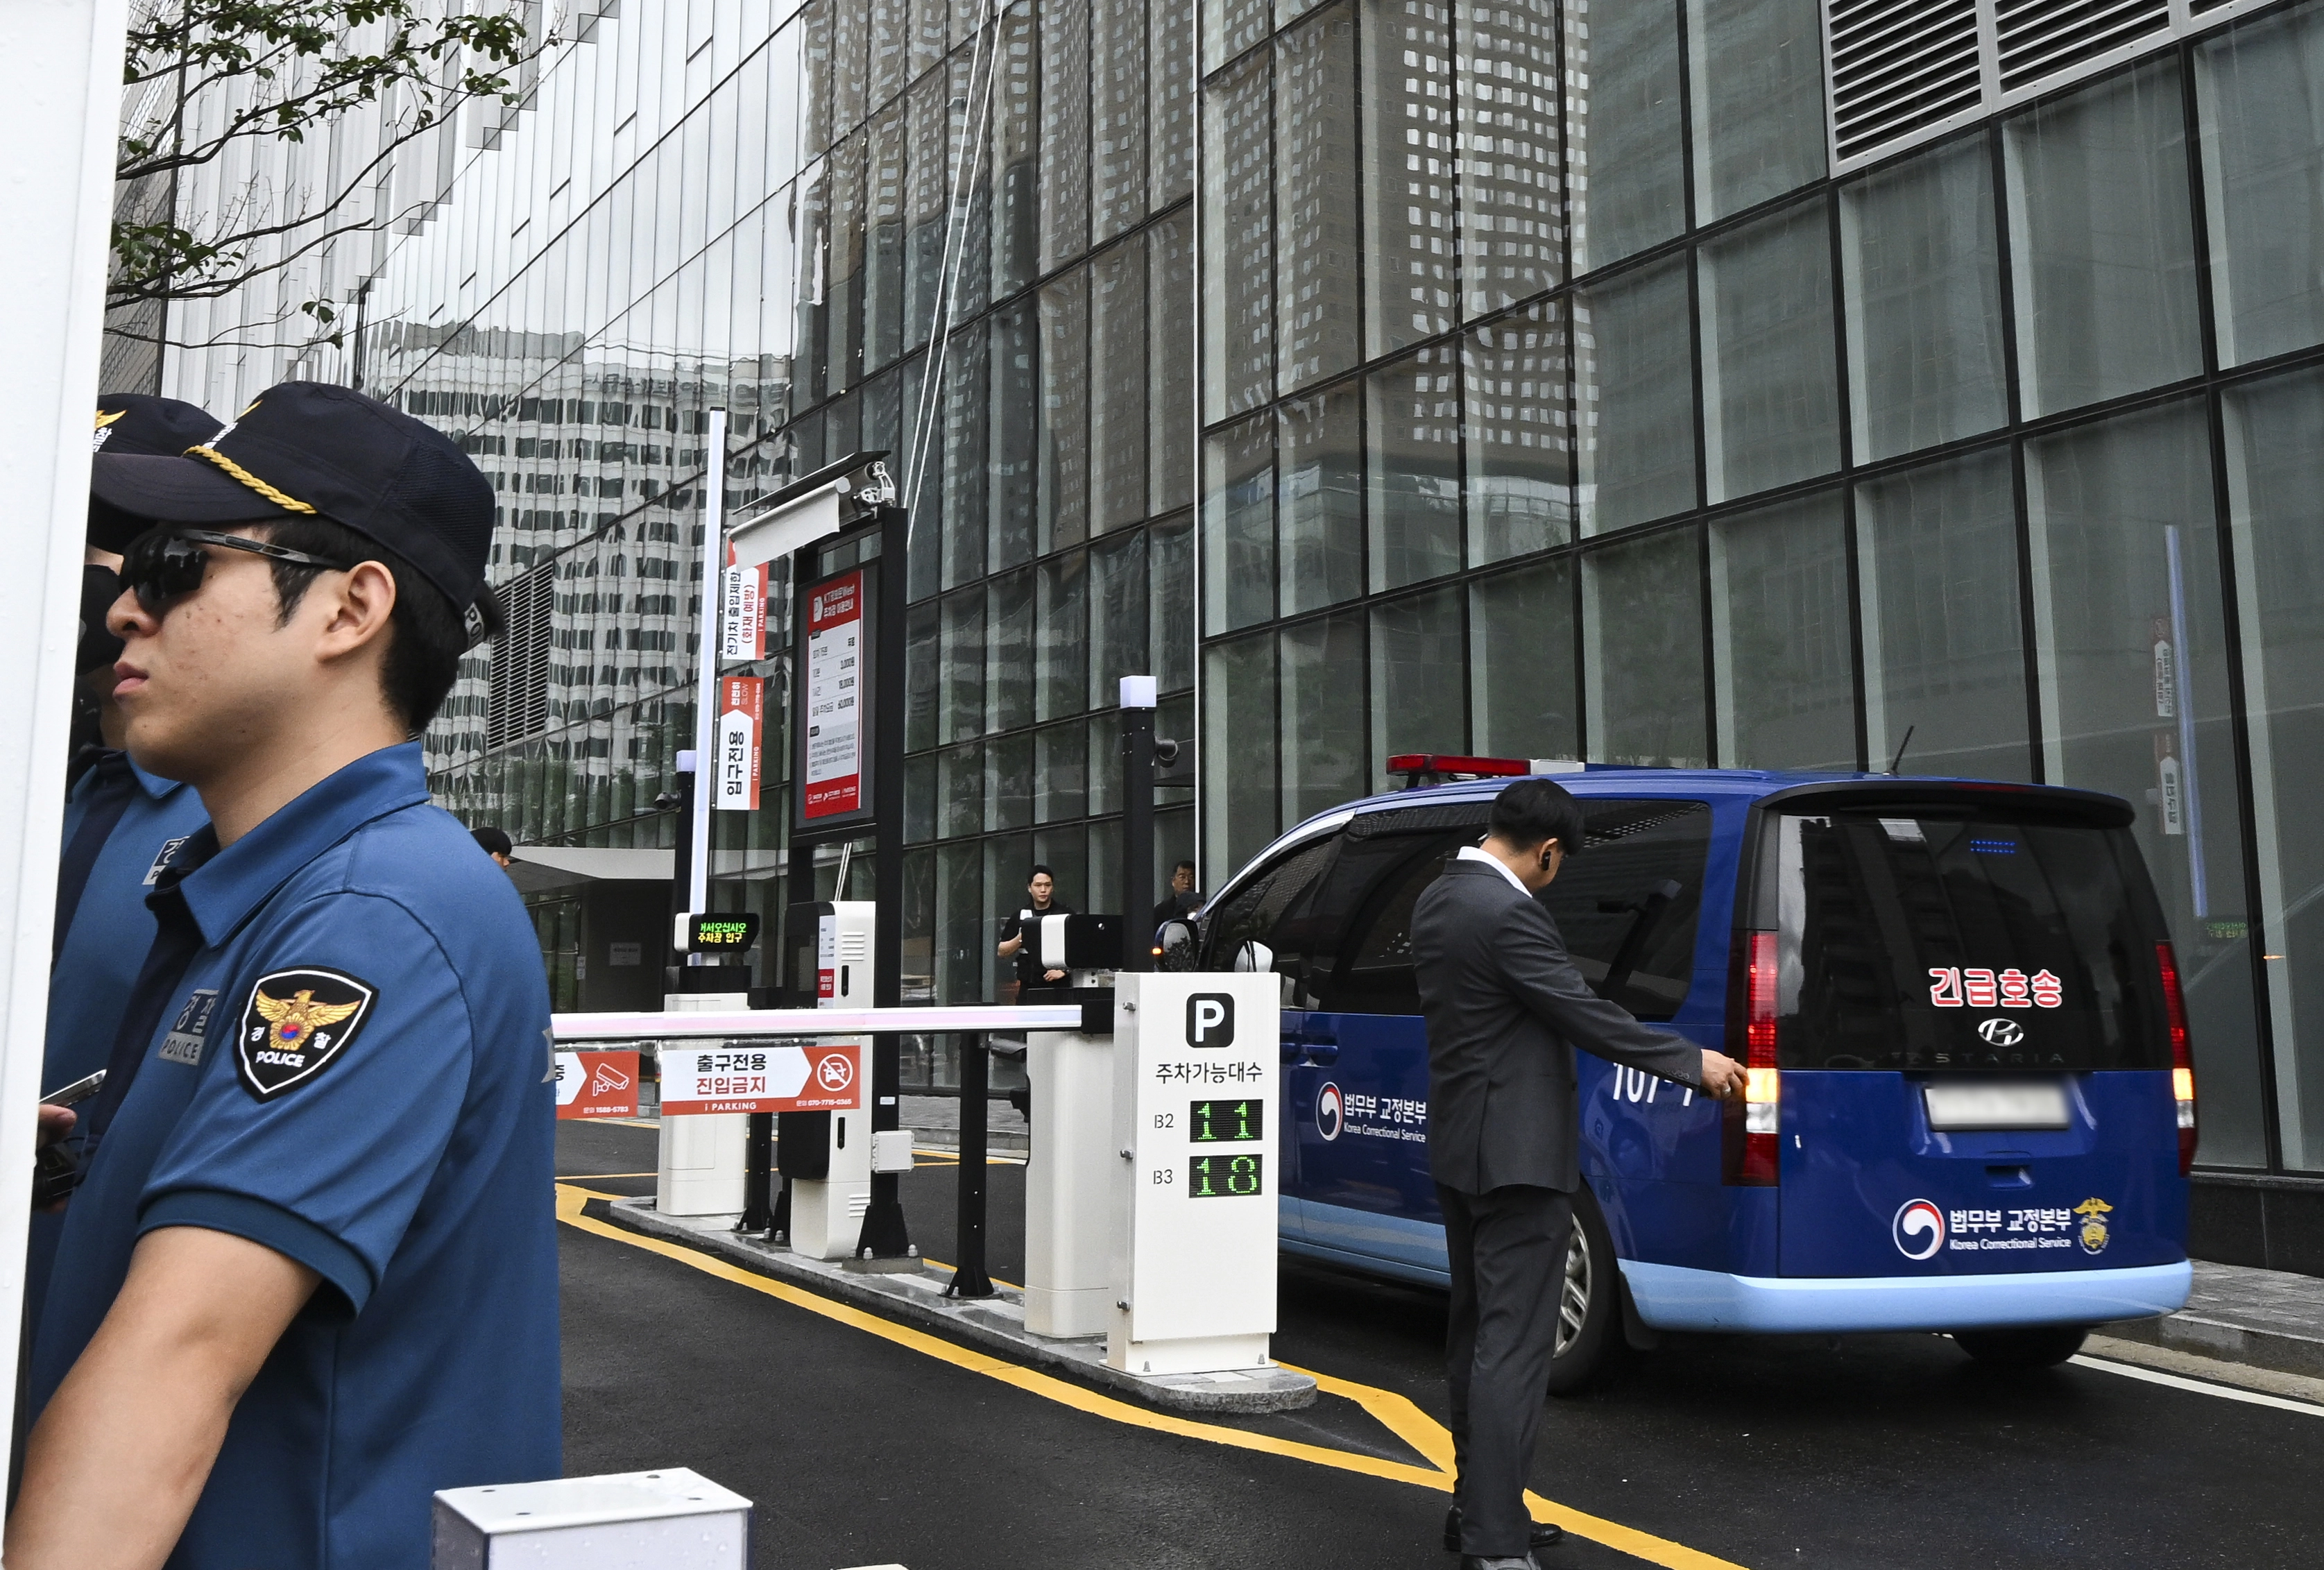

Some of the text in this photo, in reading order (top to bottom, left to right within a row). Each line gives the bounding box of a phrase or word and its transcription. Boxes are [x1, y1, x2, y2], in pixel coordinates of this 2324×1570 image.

[726, 572, 741, 656] 전기차 출입제한
[741, 584, 755, 644] (화재 예방)
[730, 682, 741, 706] 천천히
[726, 731, 744, 796] 입구전용
[697, 932, 742, 944] 주차장 입구
[1929, 966, 2062, 1008] 긴급호송
[1195, 1000, 1225, 1042] P
[161, 1039, 198, 1059] POLICE
[255, 1050, 305, 1067] POLICE
[697, 1053, 767, 1071] 출구전용
[1155, 1061, 1263, 1084] 주차가능대수
[696, 1076, 766, 1095] 진입금지
[711, 1102, 757, 1111] PARKING
[1344, 1093, 1427, 1125] 법무부 교정본부
[1154, 1113, 1174, 1129] B2
[1344, 1123, 1426, 1143] Korea Correctional Service
[1153, 1170, 1173, 1185] B3
[1949, 1208, 2071, 1234] 법무부 교정본부
[1949, 1237, 2071, 1250] Korea Correctional Service
